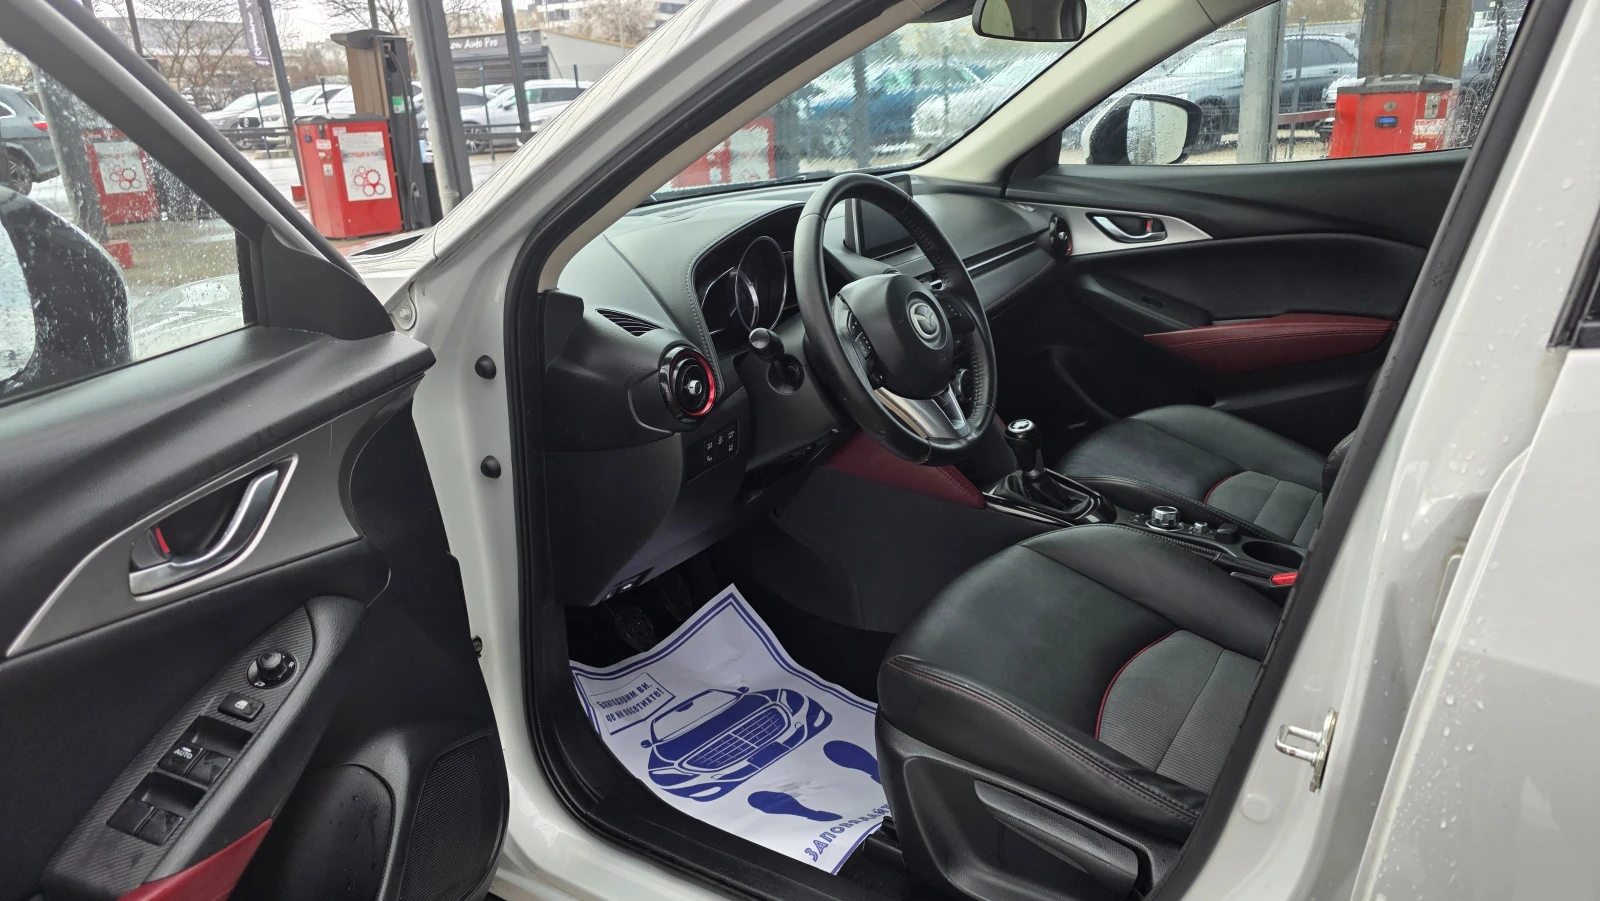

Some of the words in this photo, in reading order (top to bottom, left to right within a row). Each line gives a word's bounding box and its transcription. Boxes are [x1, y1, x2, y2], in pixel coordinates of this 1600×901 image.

[464, 38, 483, 49] Auto
[484, 37, 499, 47] Pro
[173, 749, 193, 759] AUTO
